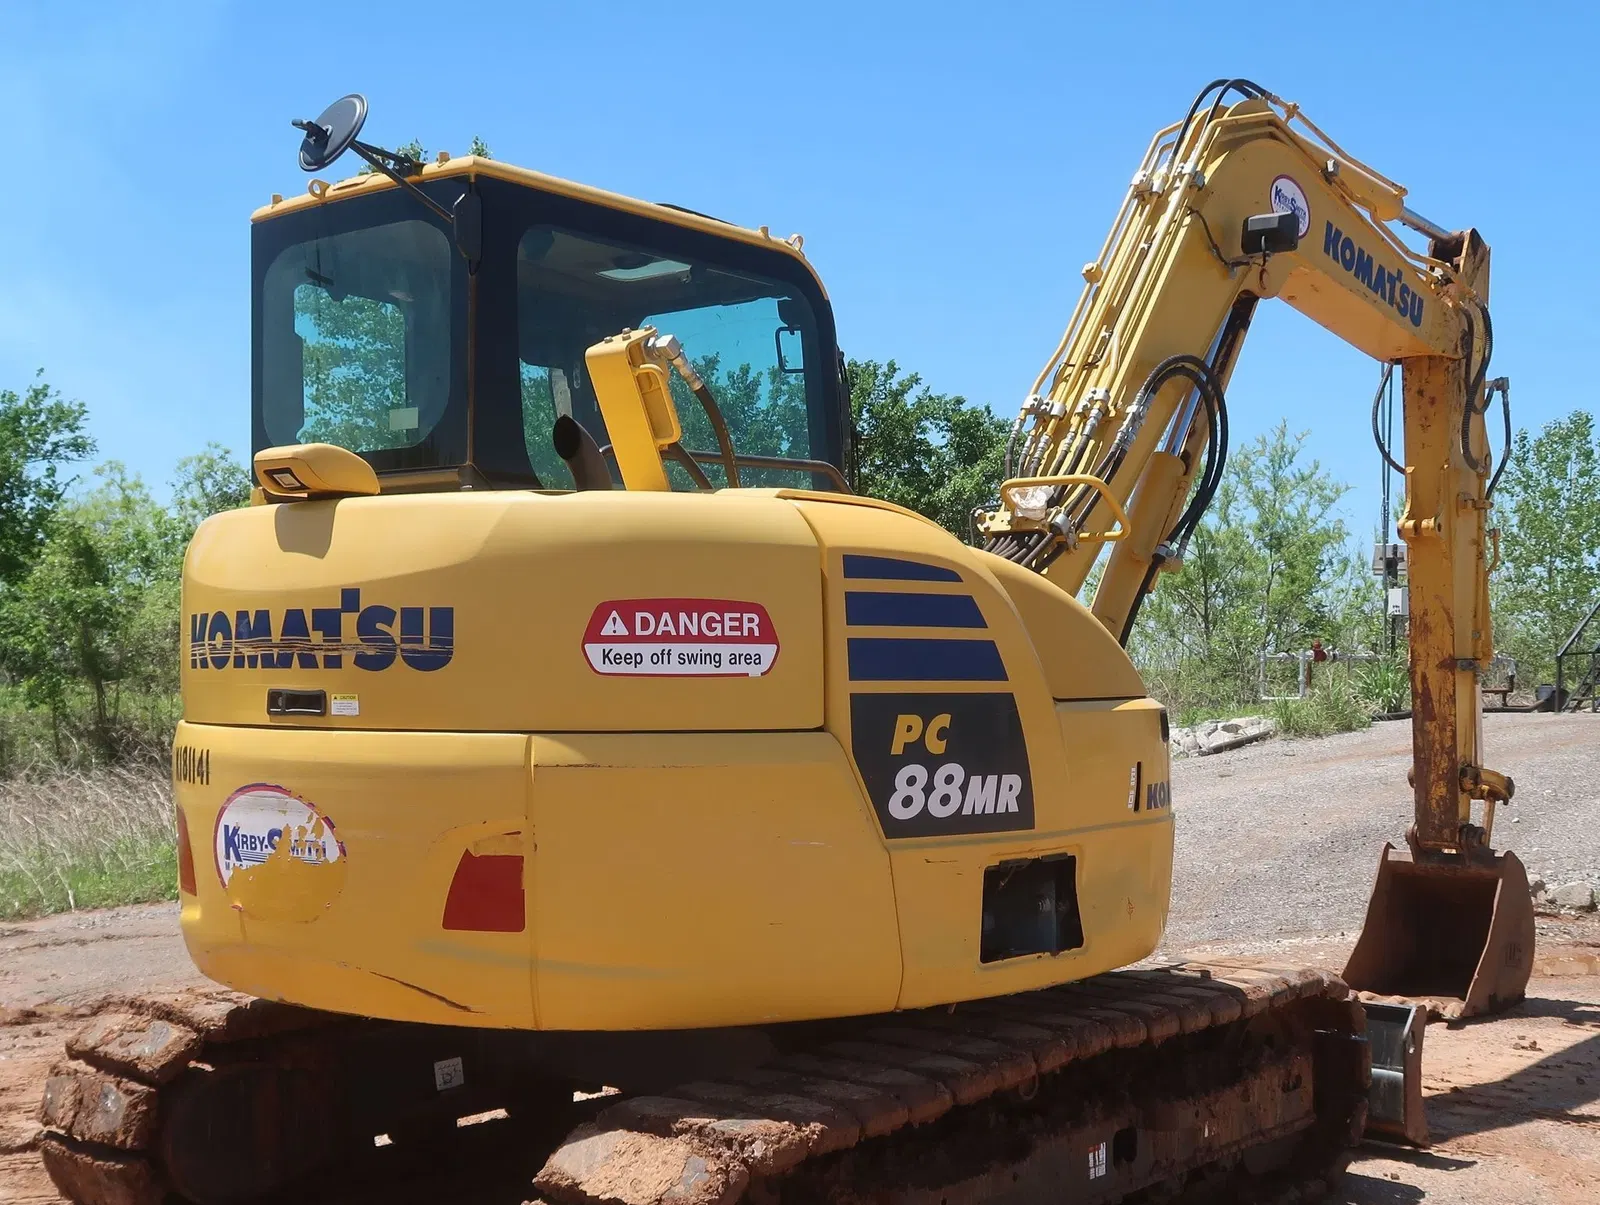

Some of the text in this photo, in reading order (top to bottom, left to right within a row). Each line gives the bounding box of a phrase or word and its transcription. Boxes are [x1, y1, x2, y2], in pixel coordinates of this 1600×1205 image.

[1324, 220, 1424, 327] KOMATSU
[190, 588, 455, 672] KOMATSU
[635, 611, 760, 636] DANGER
[602, 648, 762, 668] Keep off swing area
[890, 713, 952, 755] PC
[888, 762, 1022, 820] 88MR
